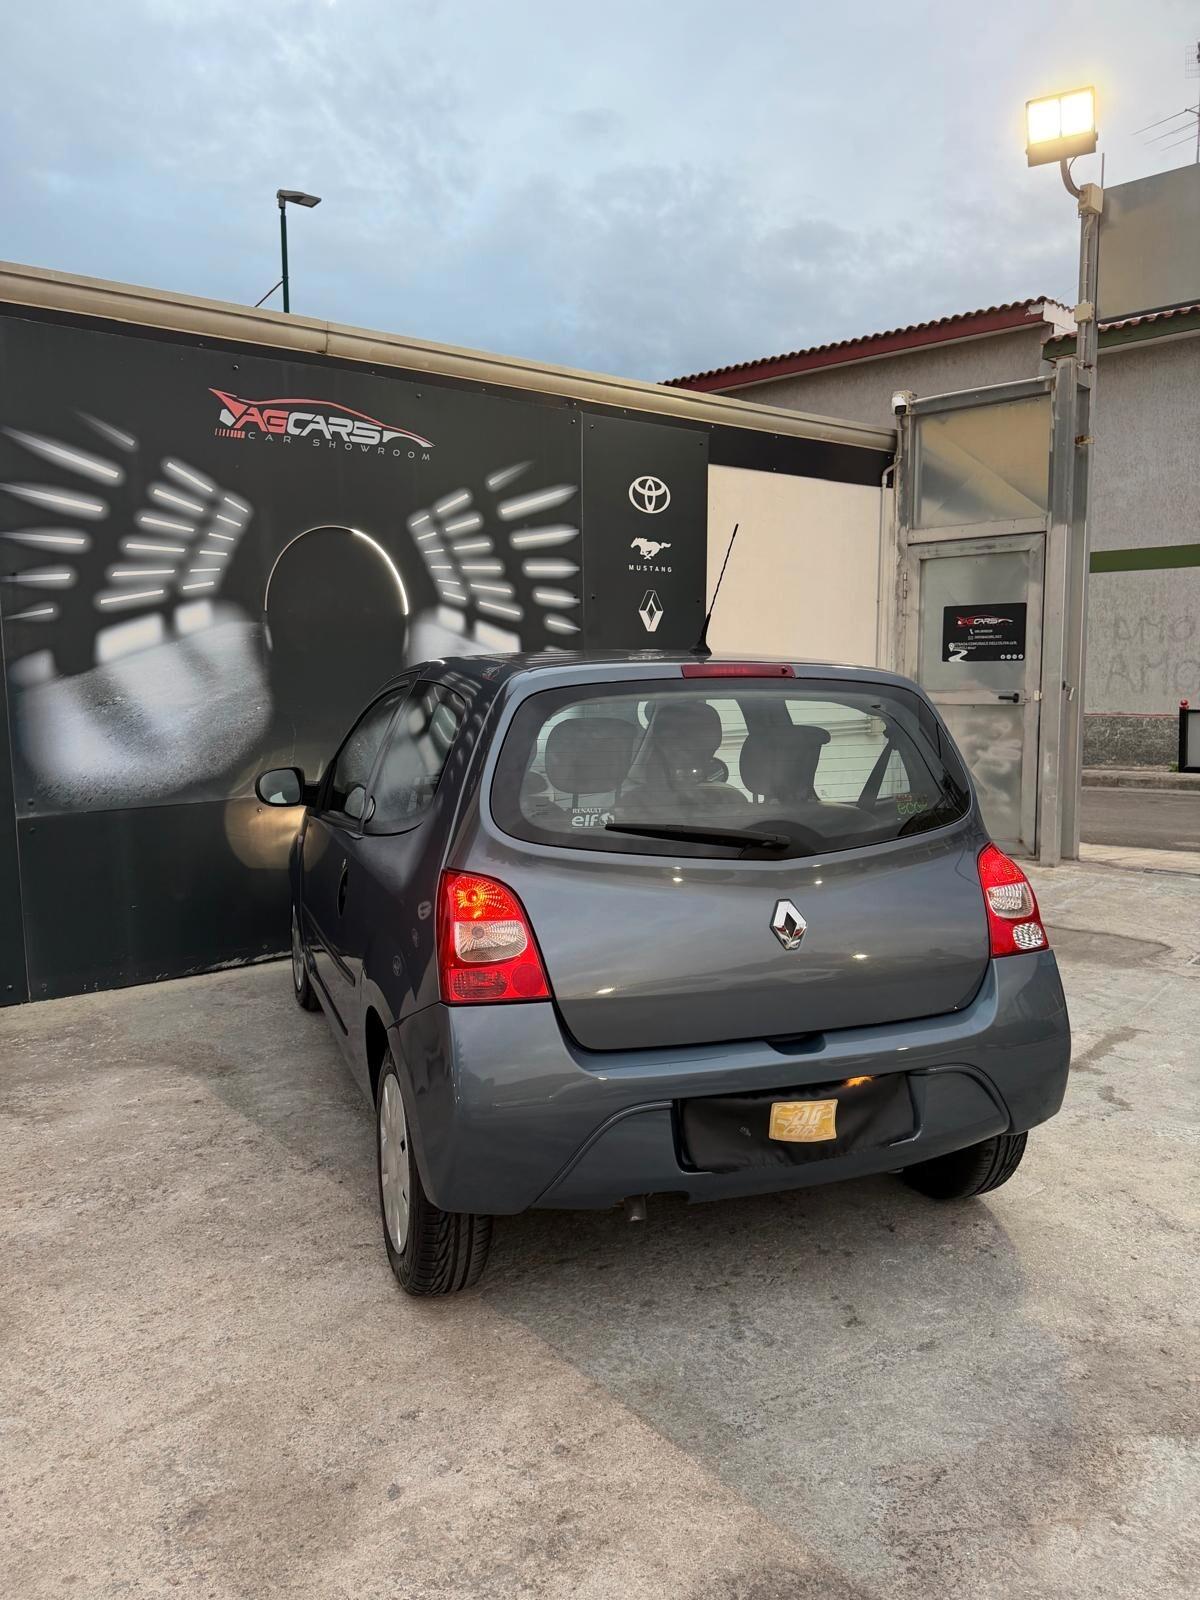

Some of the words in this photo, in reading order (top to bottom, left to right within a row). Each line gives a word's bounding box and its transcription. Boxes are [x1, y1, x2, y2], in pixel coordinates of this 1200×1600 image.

[247, 431, 292, 444] CAR
[312, 438, 431, 461] SHOWROOM
[628, 564, 673, 573] MUSTANG
[571, 814, 599, 827] elf
